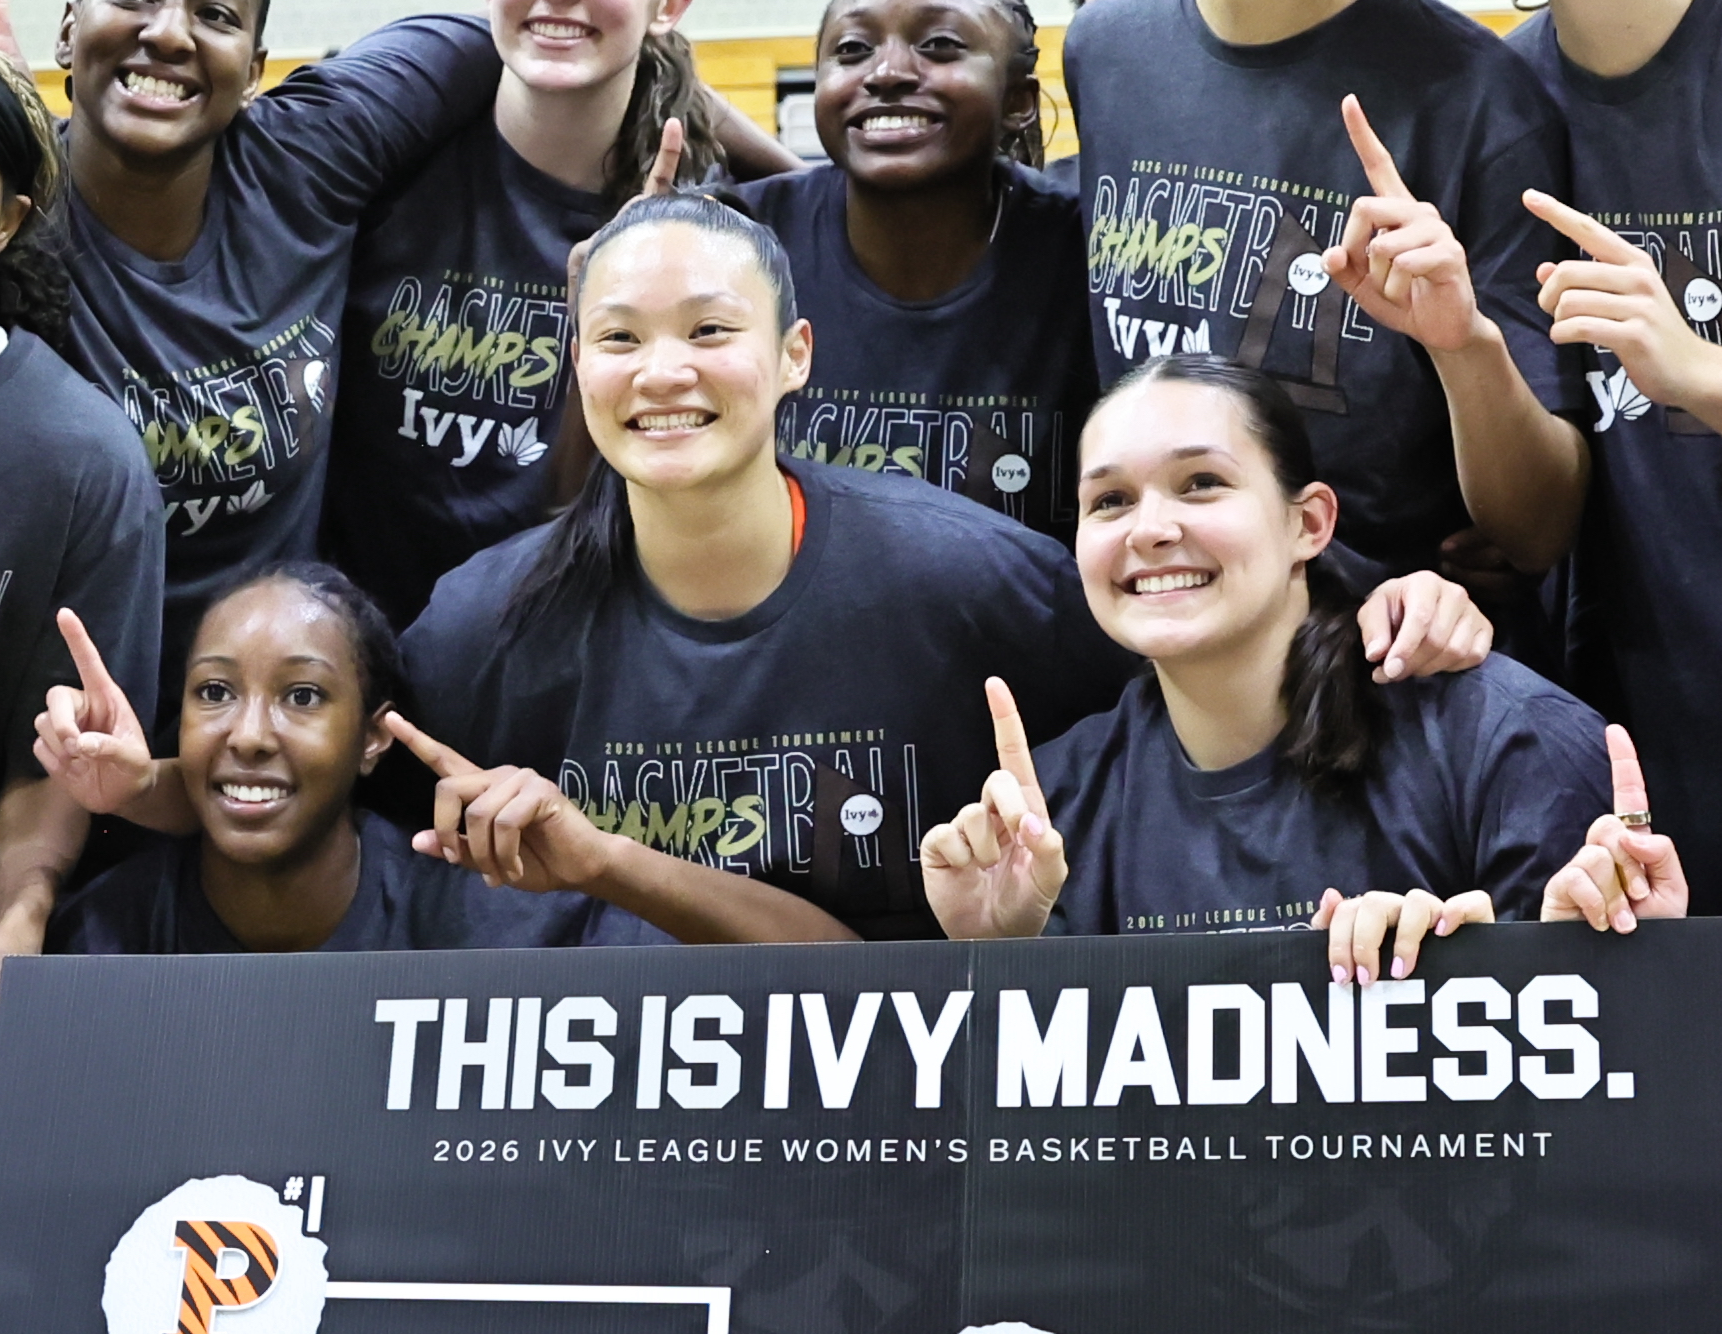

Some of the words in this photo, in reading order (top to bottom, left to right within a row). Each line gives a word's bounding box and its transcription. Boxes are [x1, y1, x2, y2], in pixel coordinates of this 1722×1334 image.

[1194, 166, 1243, 186] LEAGUE
[1088, 214, 1228, 286] CHAMPS
[370, 309, 561, 388] CHAMPS
[397, 387, 496, 467] Ivy
[696, 736, 760, 755] LEAGUE
[844, 809, 867, 824] Ivy
[374, 996, 619, 1112] THIS
[635, 994, 745, 1112] IS
[763, 990, 975, 1110] IVY
[996, 974, 1636, 1109] MADNESS.
[434, 1140, 521, 1164] 2026
[538, 1139, 597, 1163] IVY
[615, 1139, 764, 1163] LEAGUE
[781, 1138, 970, 1163] WOMEN'S
[989, 1135, 1248, 1162] BASKETBALL
[1265, 1131, 1554, 1161] TOURNAMENT
